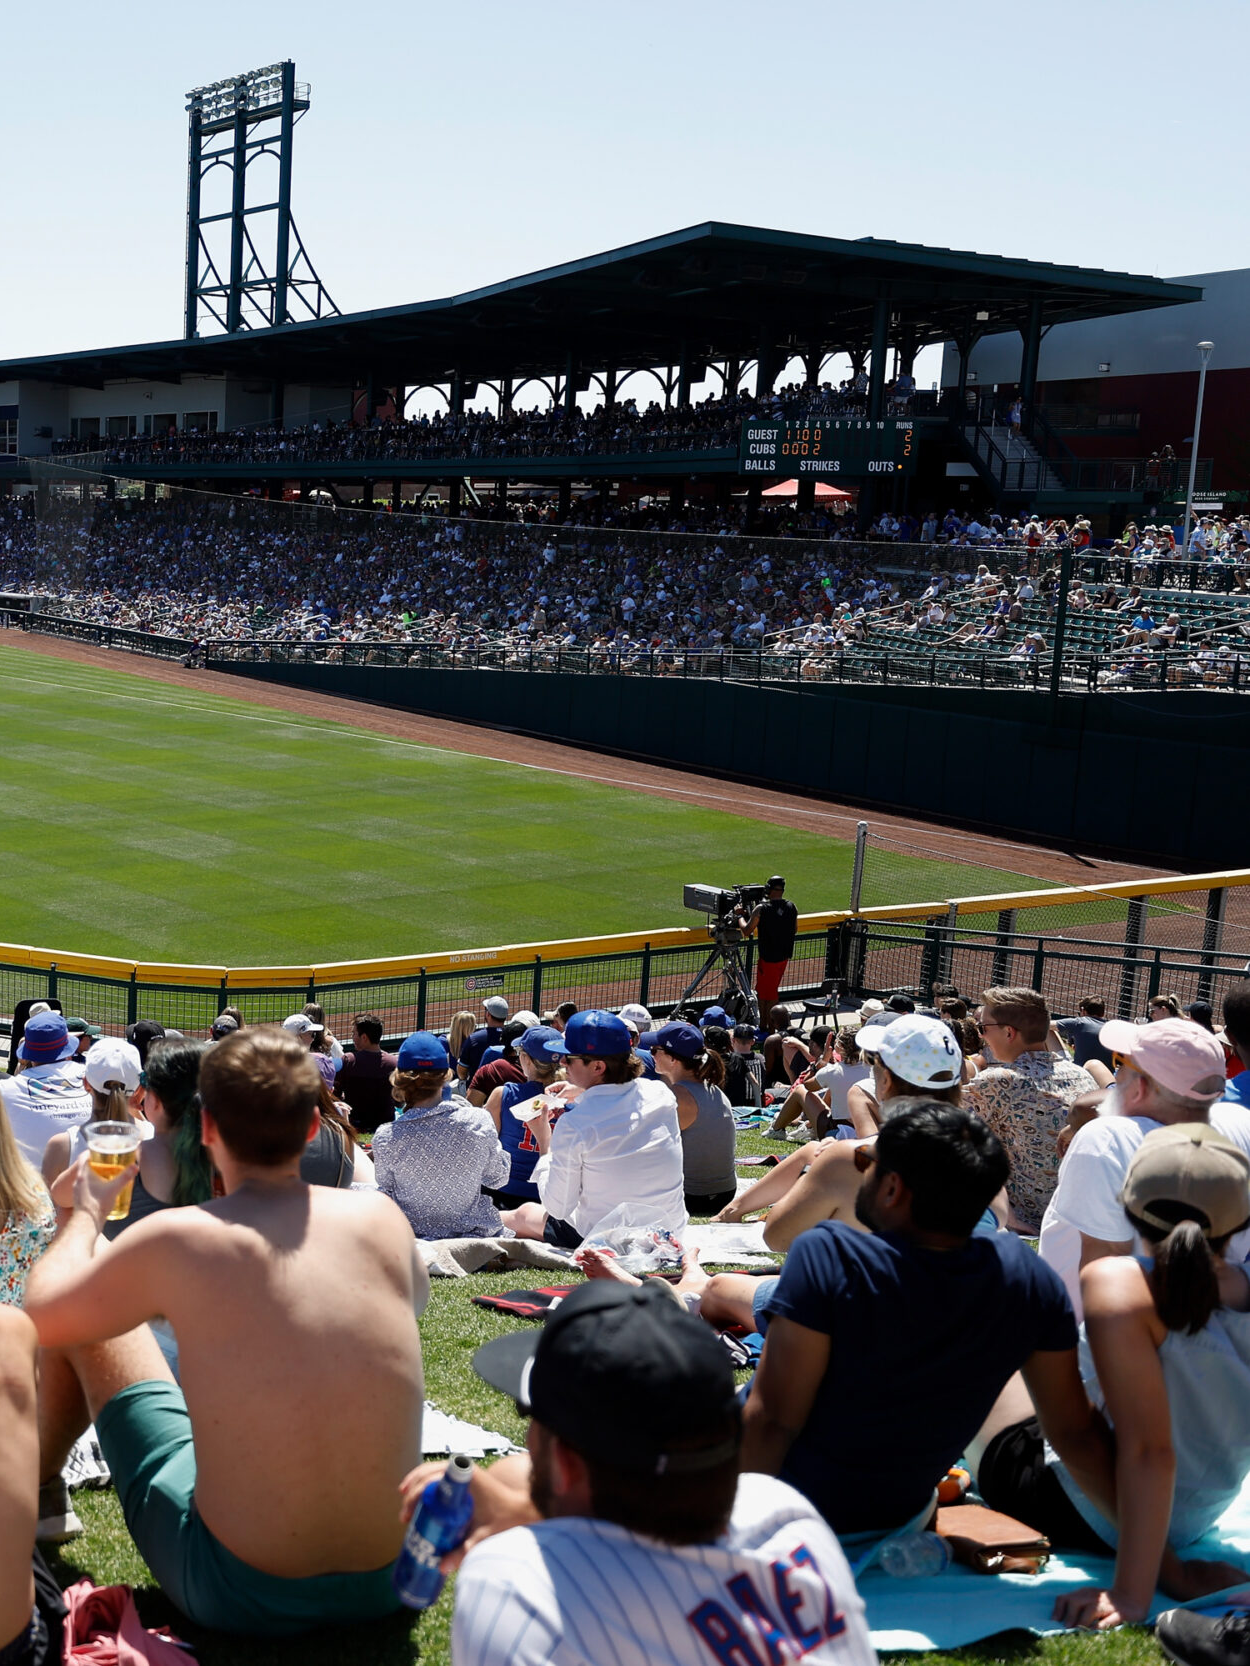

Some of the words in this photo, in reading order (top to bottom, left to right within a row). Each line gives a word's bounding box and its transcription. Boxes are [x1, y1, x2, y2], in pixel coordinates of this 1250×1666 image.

[896, 421, 913, 429] RUNS
[747, 429, 778, 440] GUEST
[802, 429, 810, 441] 0
[814, 429, 821, 441] 0
[904, 430, 912, 441] 2
[749, 443, 776, 454] CUBS
[782, 443, 789, 455] 0
[791, 443, 799, 455] 0
[801, 443, 808, 455] 0
[813, 443, 821, 455] 2
[903, 444, 912, 456] 2
[745, 460, 776, 471] BALLS
[800, 460, 840, 471] STRIKES
[868, 461, 894, 472] OUTS
[450, 955, 461, 963] NO
